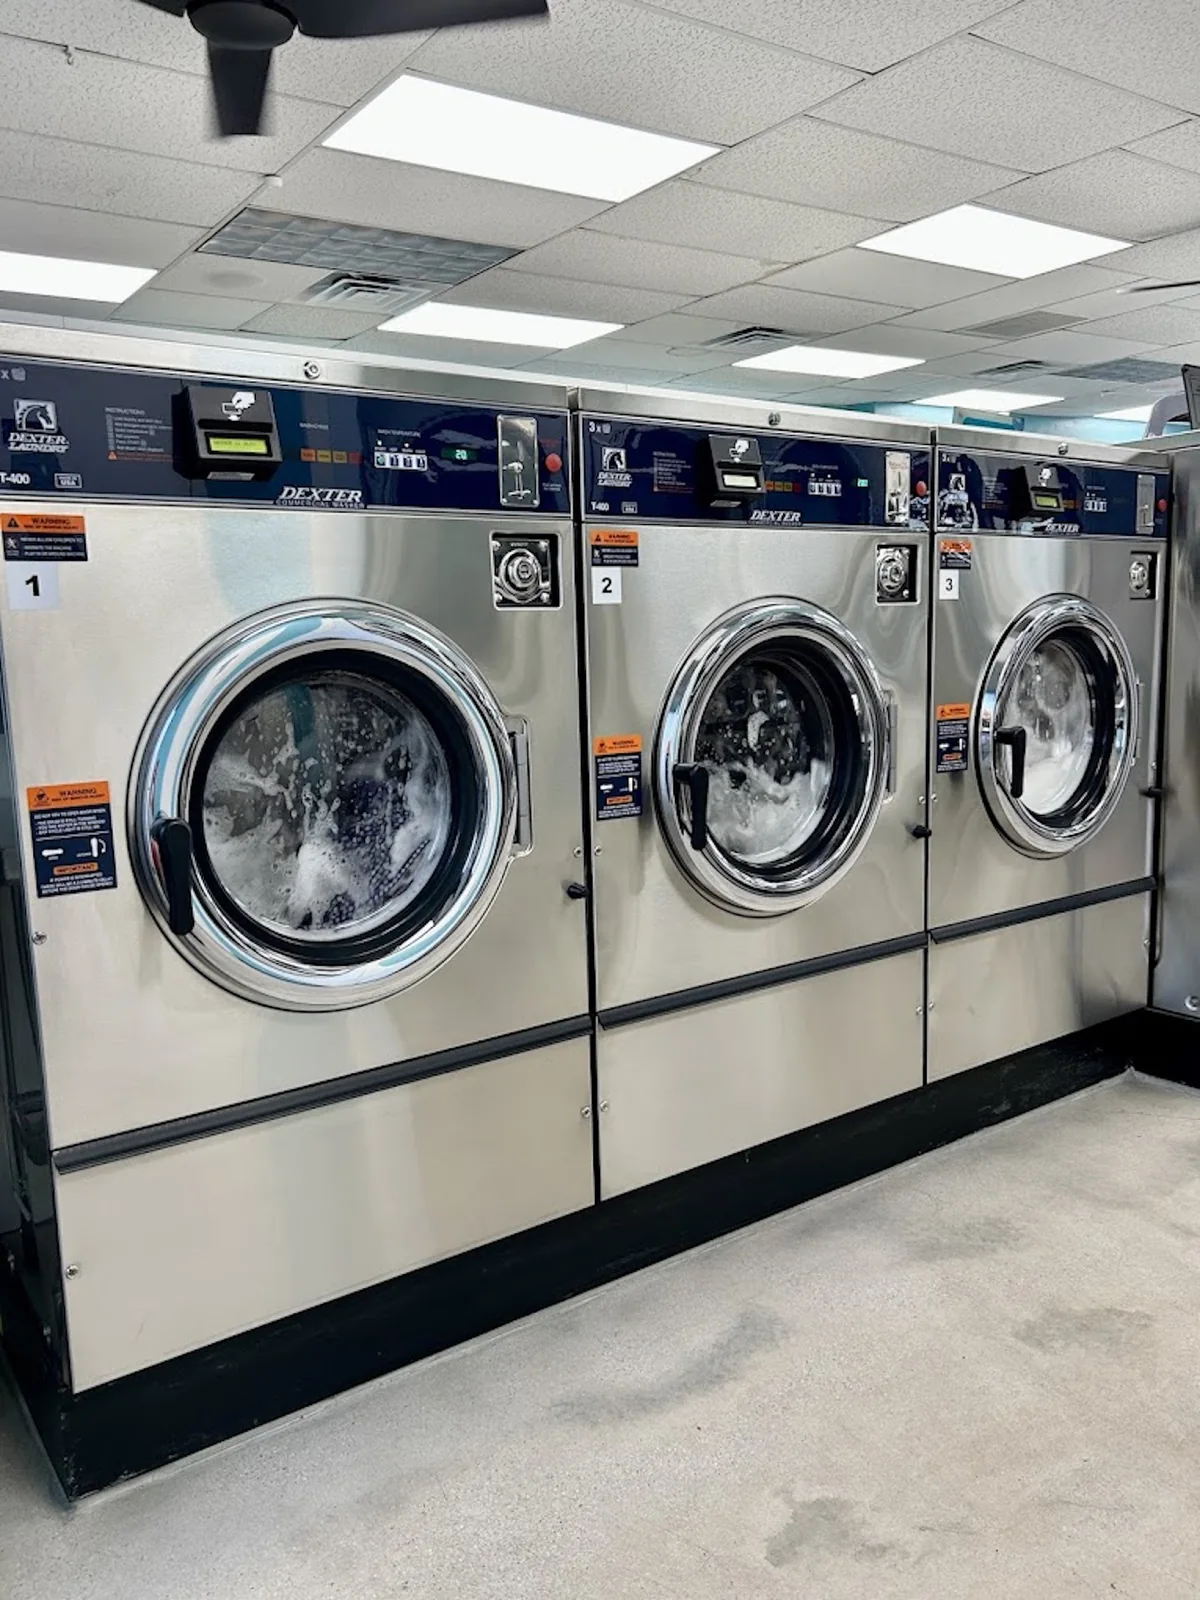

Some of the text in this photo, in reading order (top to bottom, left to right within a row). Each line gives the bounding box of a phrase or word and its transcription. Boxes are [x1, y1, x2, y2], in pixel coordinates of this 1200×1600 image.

[589, 421, 595, 433] 3
[8, 431, 67, 445] DEXTER
[8, 441, 69, 454] LAUNDRY
[0, 471, 31, 485] T-400
[597, 471, 632, 481] DEXTER
[279, 485, 362, 502] DEXTER
[750, 509, 801, 522] DEXTER
[25, 574, 40, 597] 1
[602, 577, 613, 594] 2
[945, 577, 953, 591] 3
[58, 787, 97, 797] WARNING
